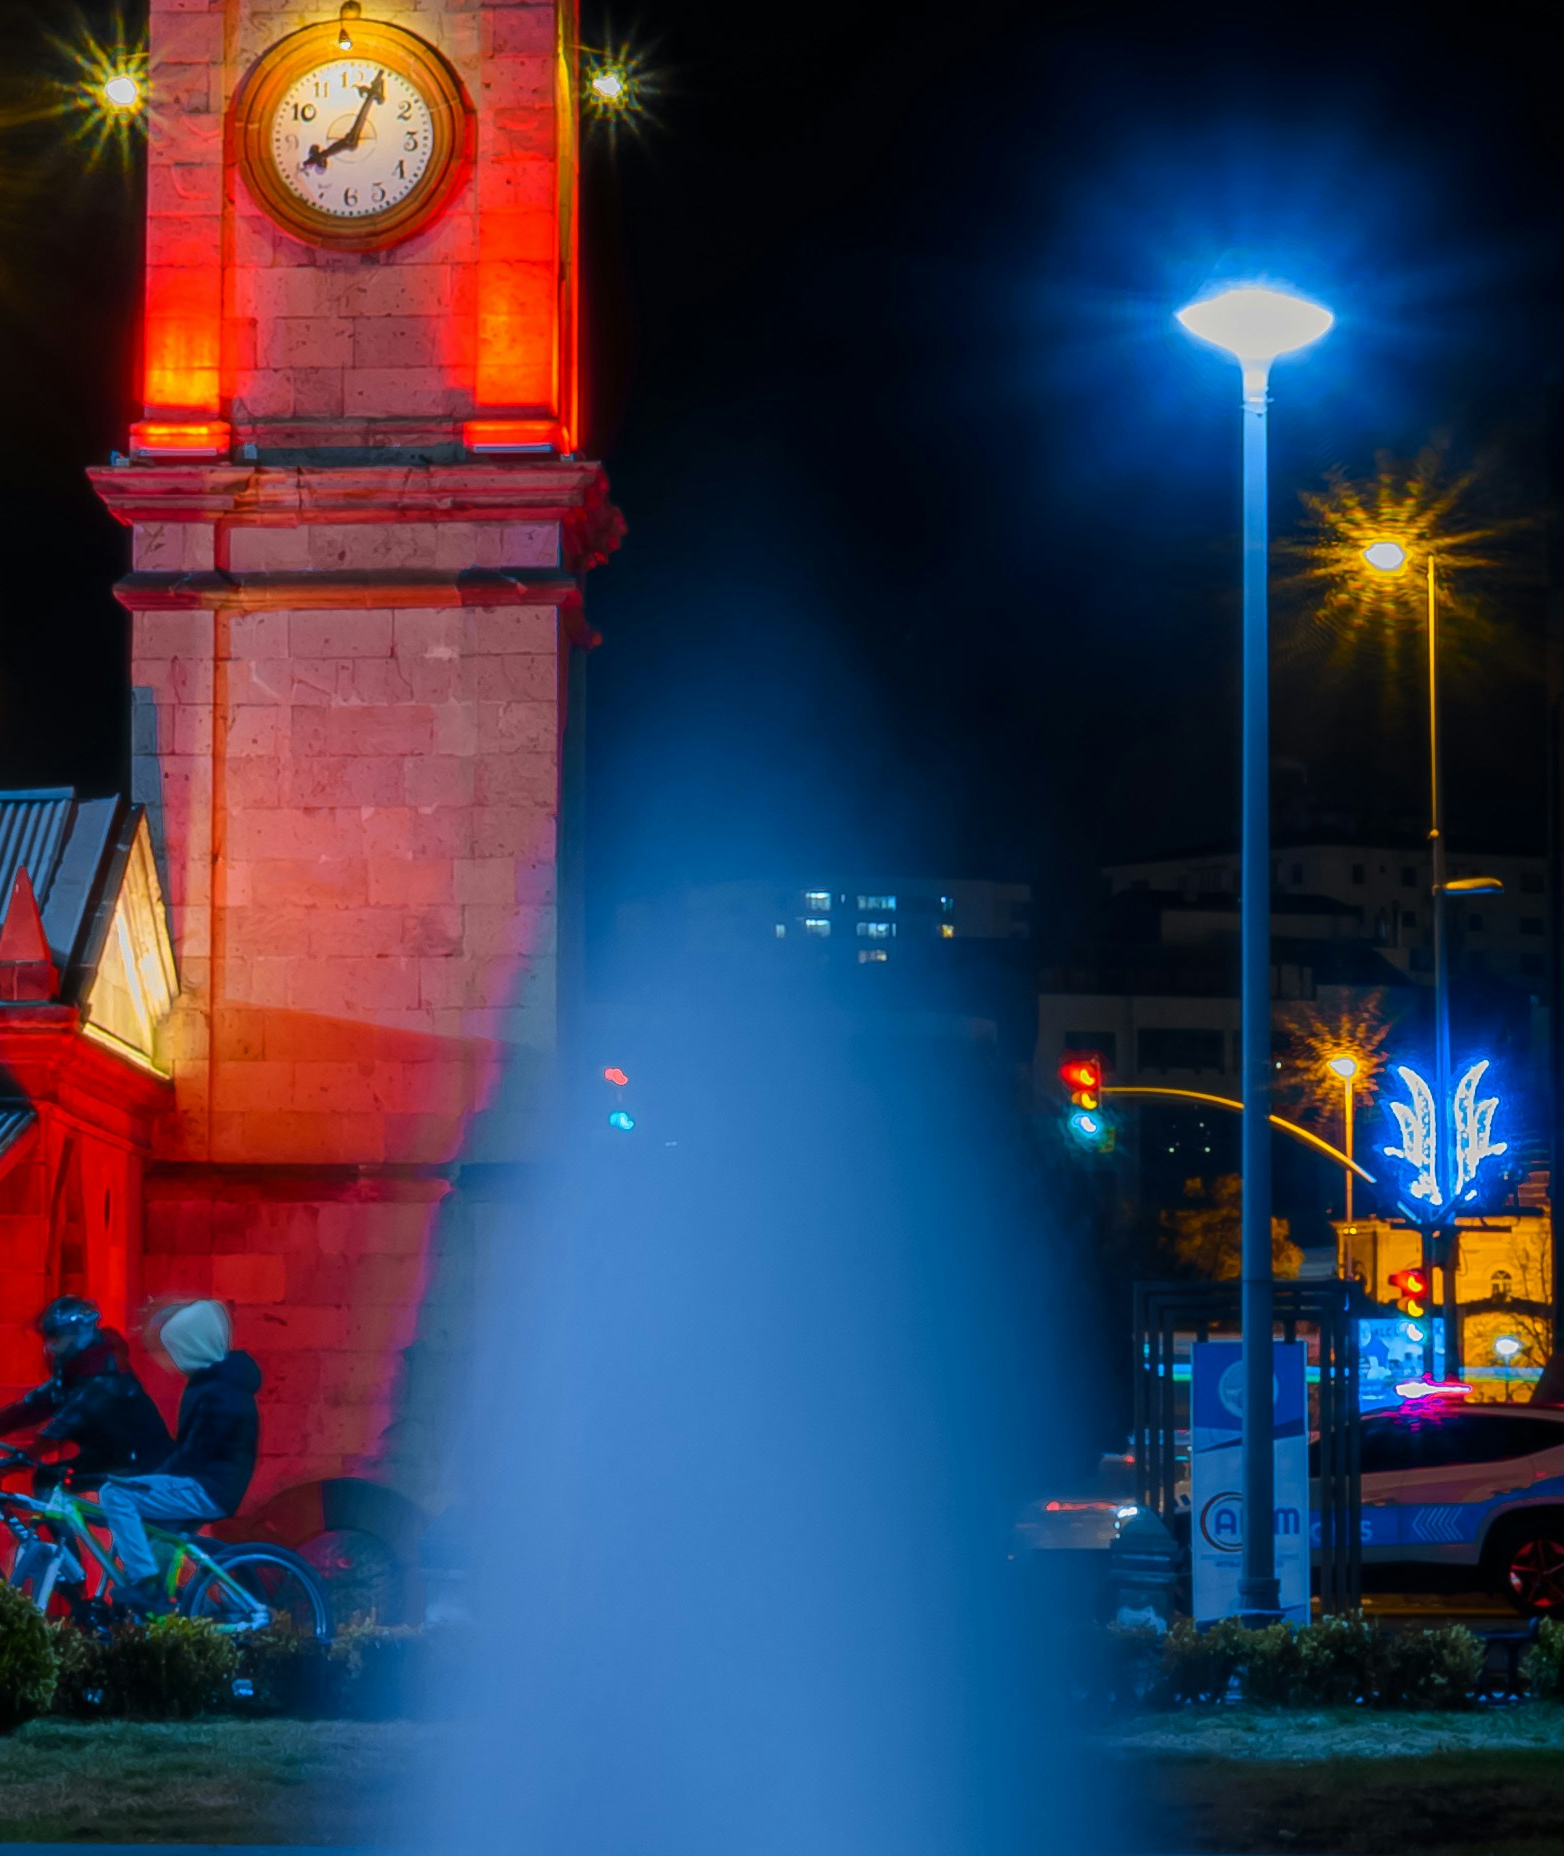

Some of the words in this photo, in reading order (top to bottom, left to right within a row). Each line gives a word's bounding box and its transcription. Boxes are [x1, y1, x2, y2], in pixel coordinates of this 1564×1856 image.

[314, 81, 329, 98] 11
[292, 102, 317, 122] 10
[397, 100, 413, 122] 2
[285, 134, 299, 151] 9
[404, 131, 418, 152] 3
[392, 160, 406, 180] 4
[343, 187, 358, 207] 6
[371, 182, 386, 203] 5
